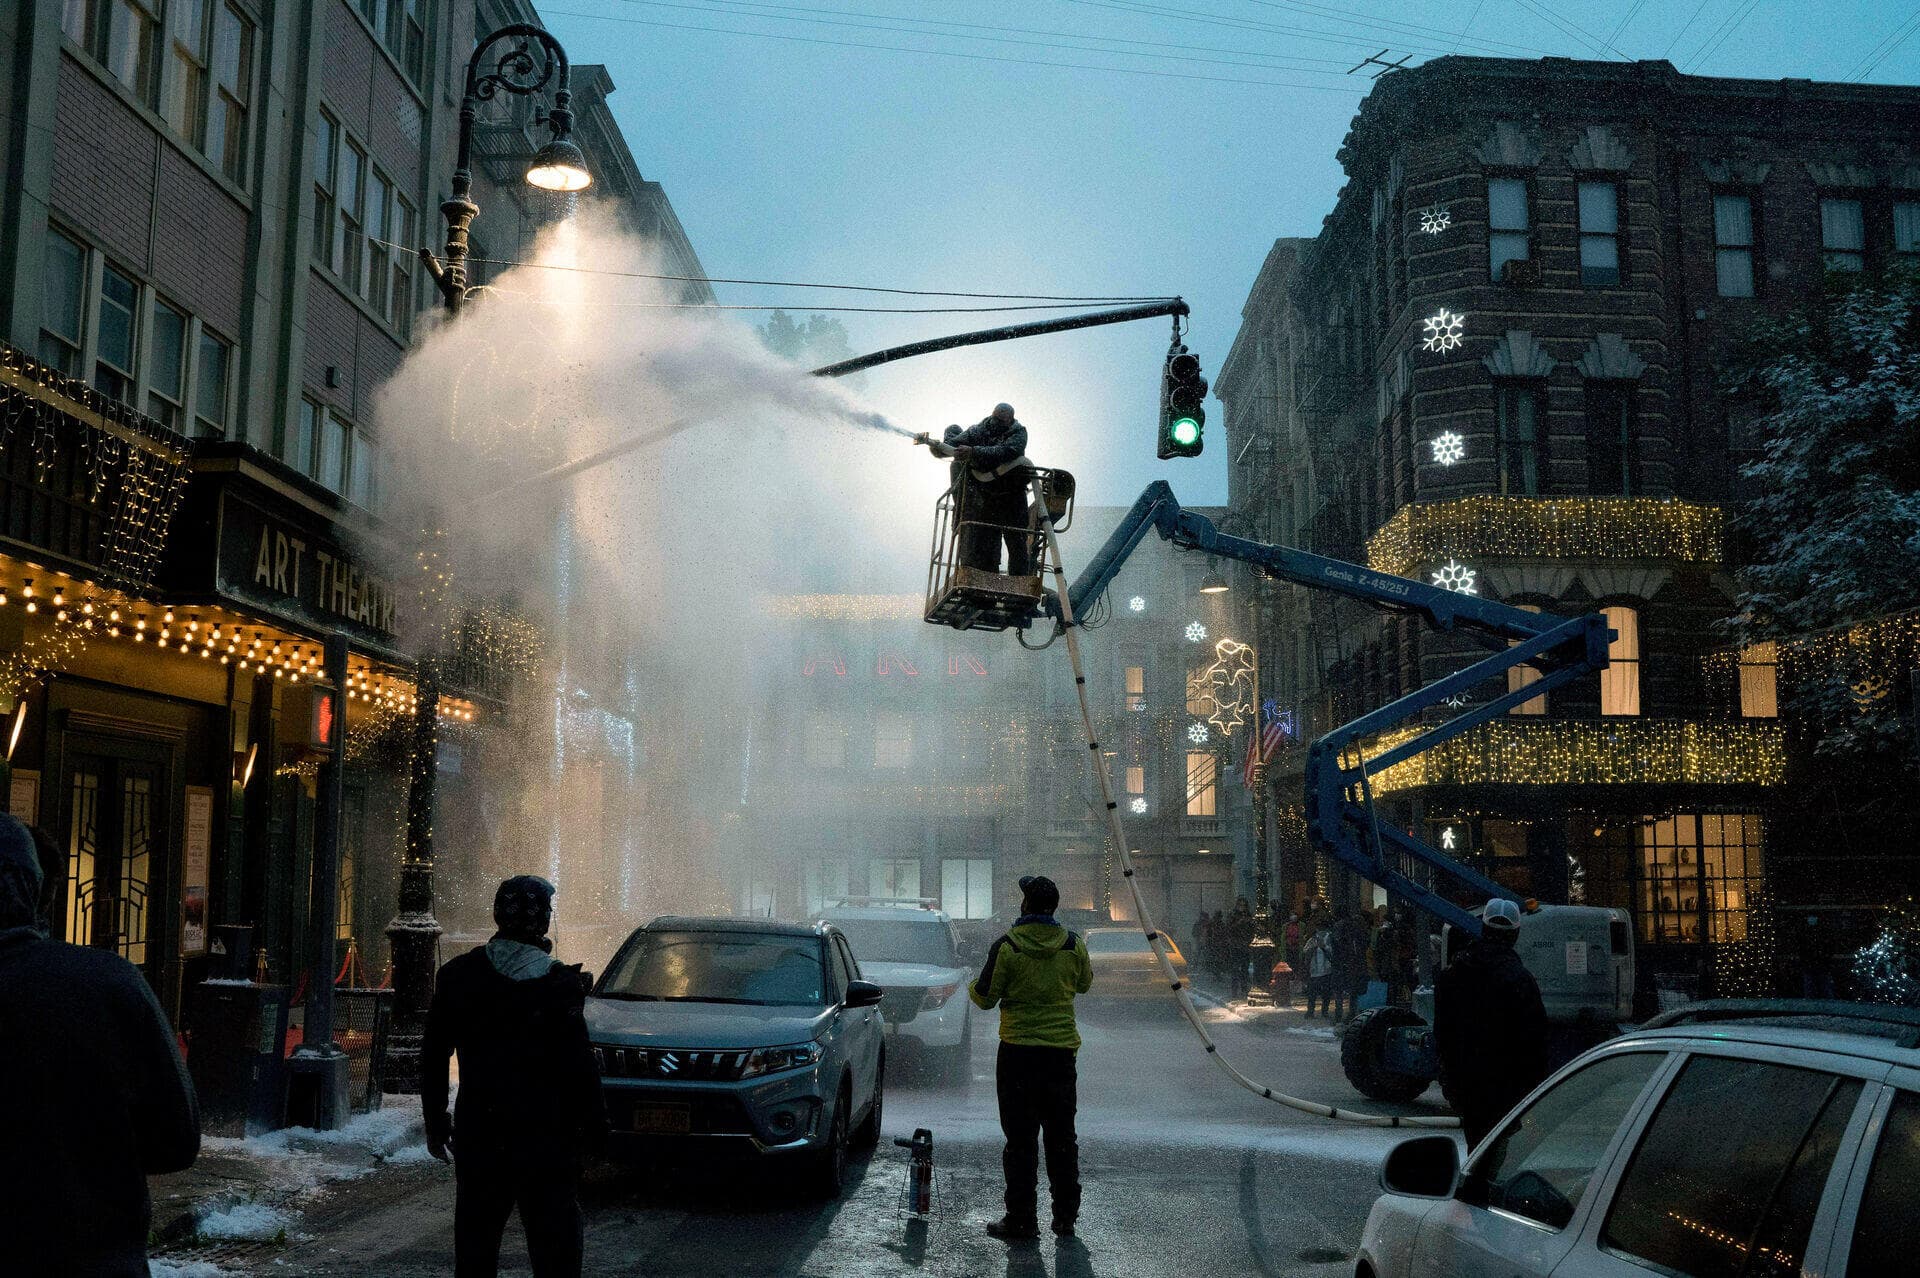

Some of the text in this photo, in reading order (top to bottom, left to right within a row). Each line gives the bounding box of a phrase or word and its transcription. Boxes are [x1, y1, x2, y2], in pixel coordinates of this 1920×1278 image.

[255, 523, 397, 634] ART THEATR
[1324, 566, 1354, 582] Genie
